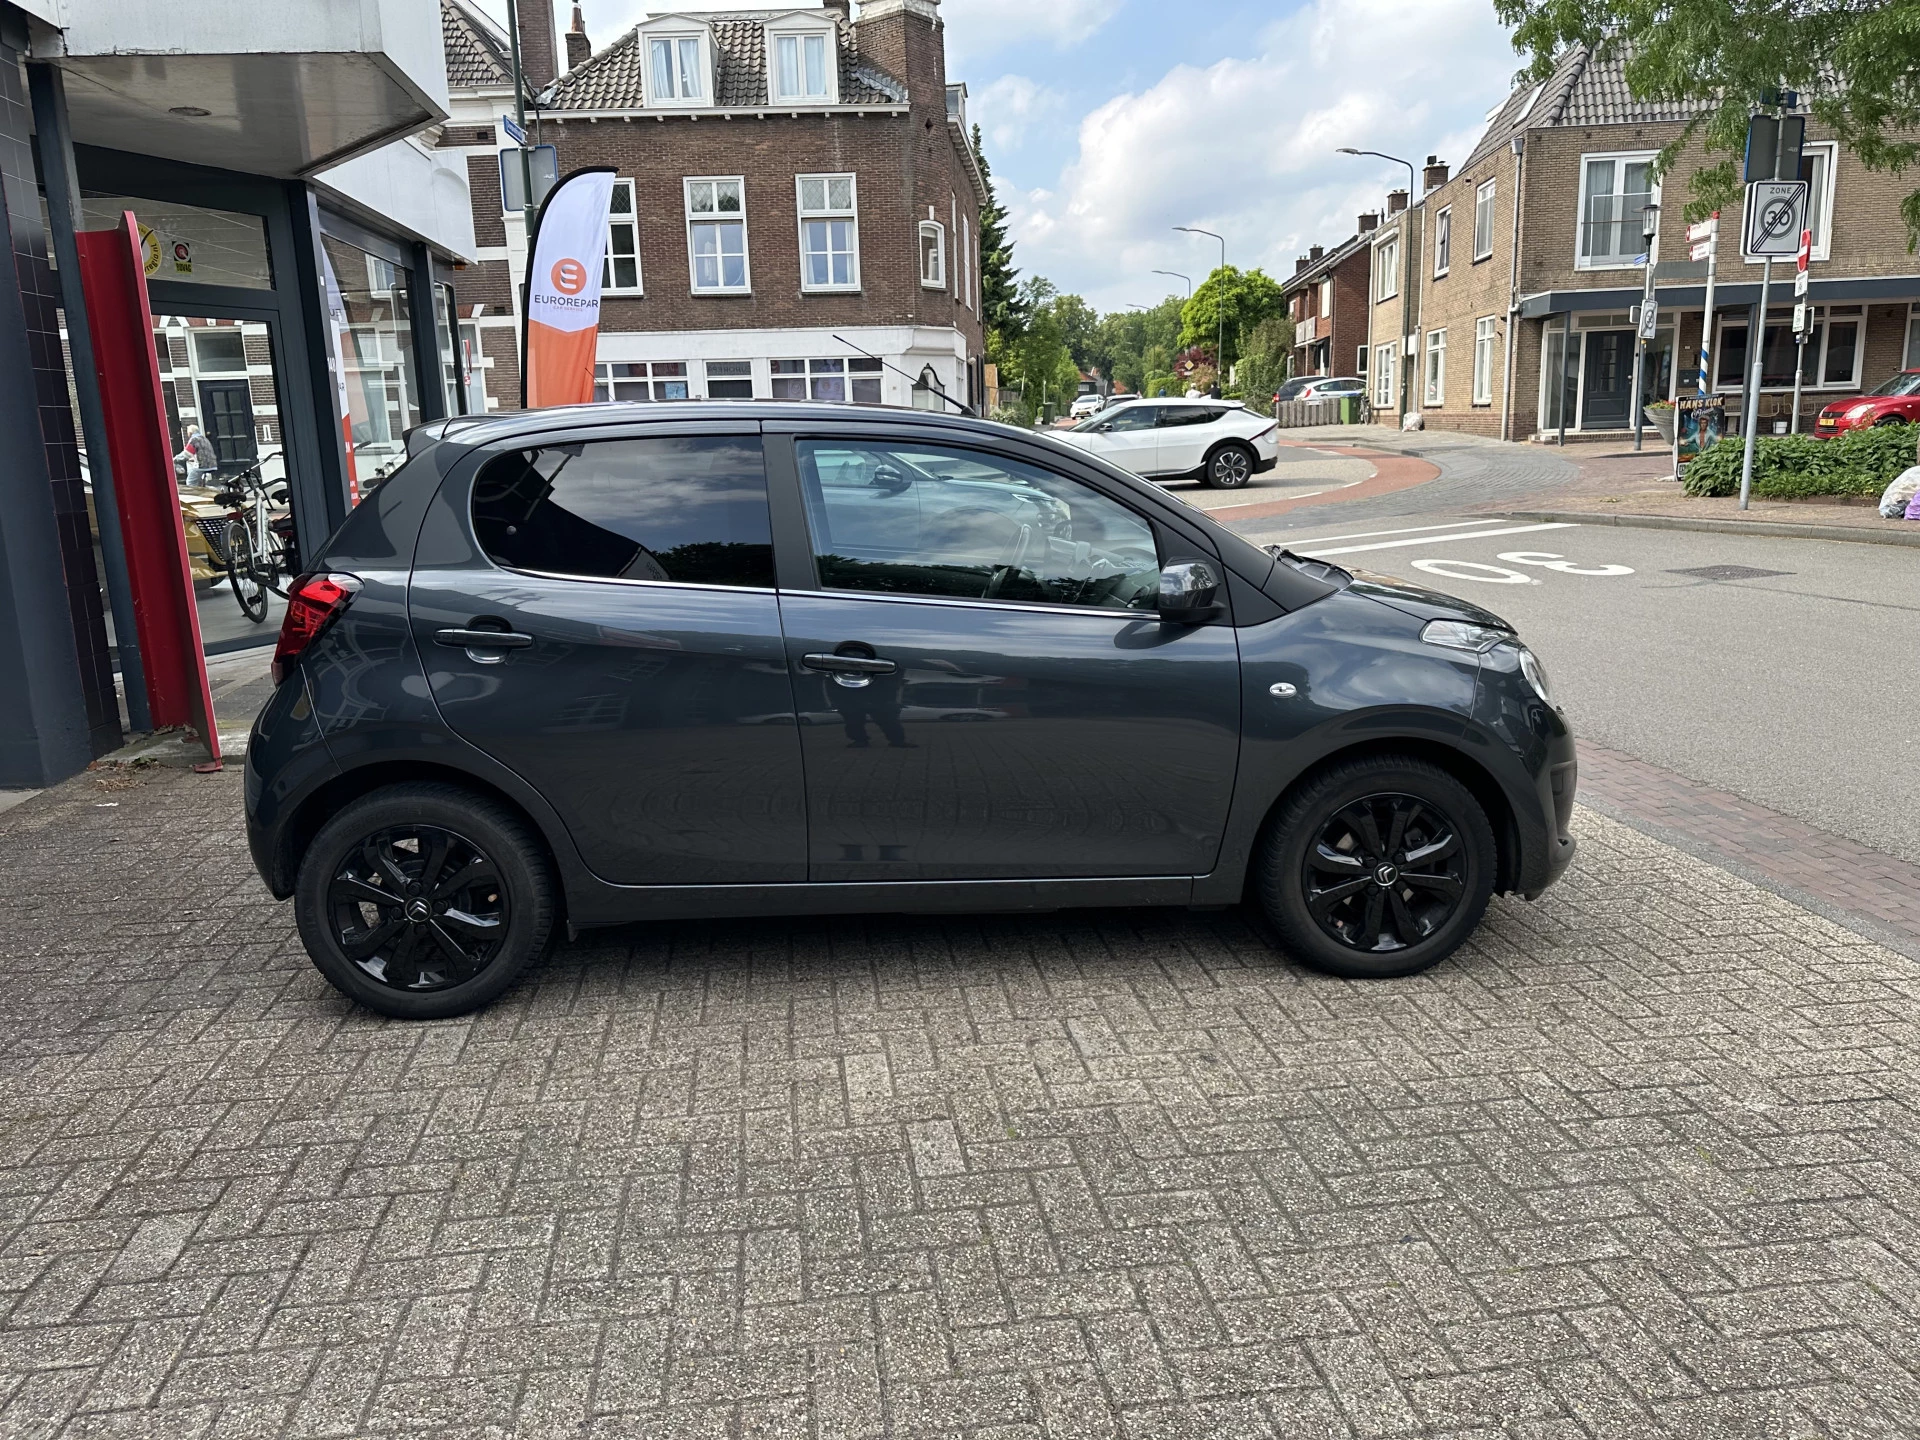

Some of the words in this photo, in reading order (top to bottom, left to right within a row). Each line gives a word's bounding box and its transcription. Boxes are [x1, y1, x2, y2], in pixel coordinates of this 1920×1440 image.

[1766, 211, 1790, 226] 30
[534, 294, 599, 308] EUROREPAR
[1680, 400, 1703, 409] HANS
[1705, 397, 1723, 406] KLOK
[1411, 551, 1635, 584] 30
